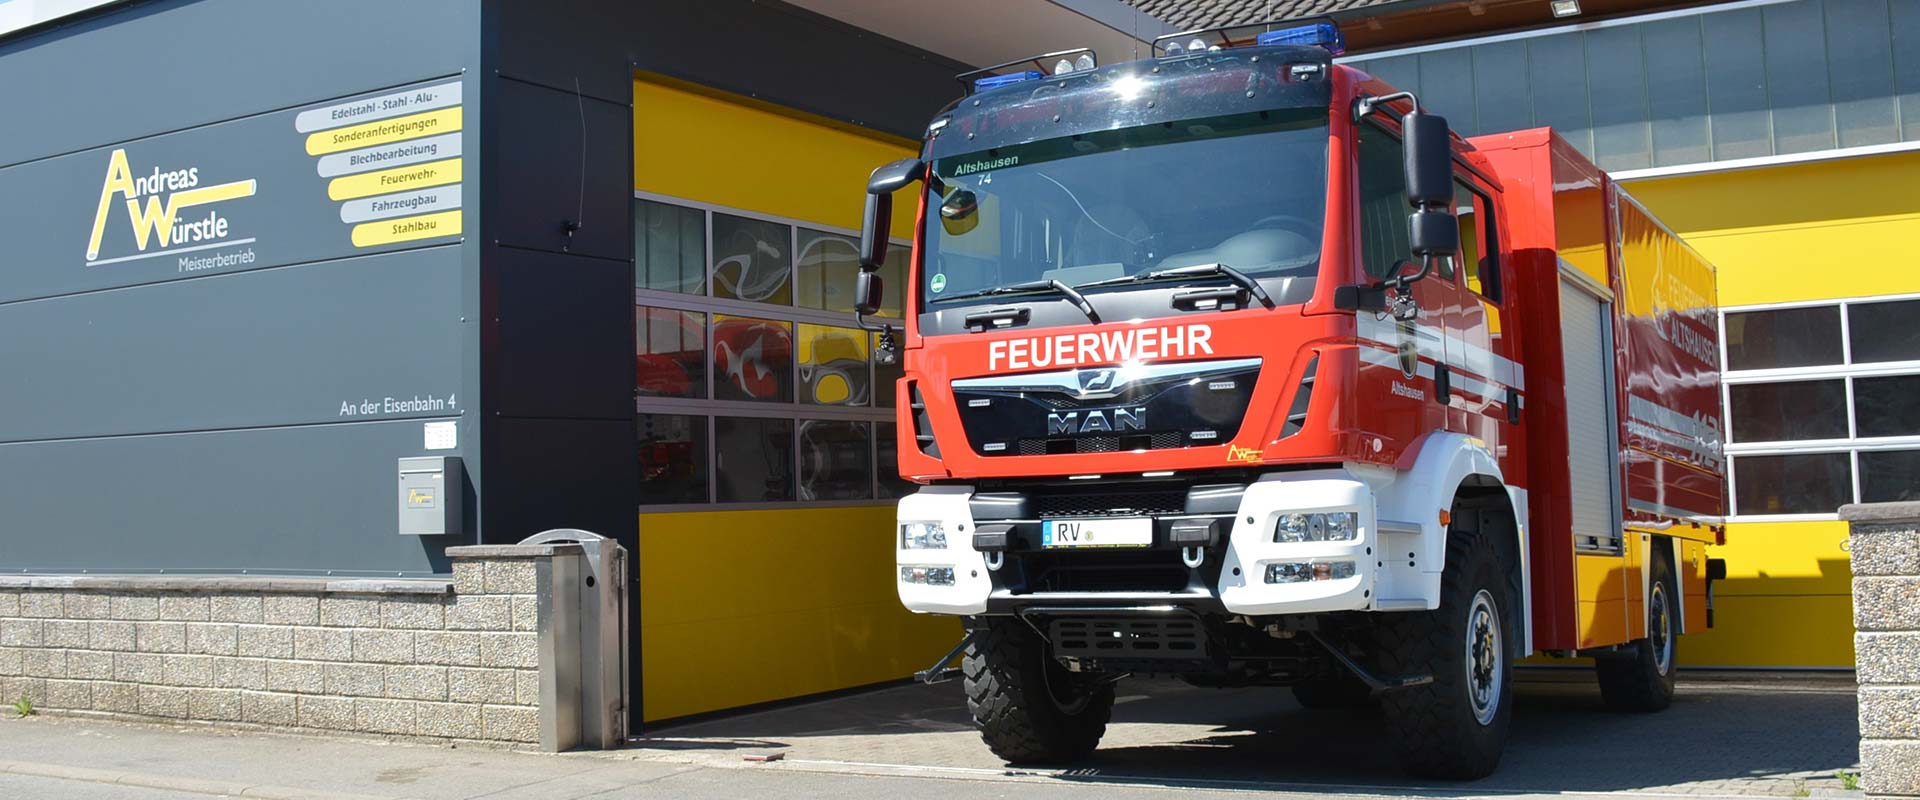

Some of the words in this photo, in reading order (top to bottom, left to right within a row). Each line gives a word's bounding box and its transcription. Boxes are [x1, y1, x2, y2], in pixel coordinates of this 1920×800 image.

[332, 103, 376, 120] Edelstahl
[383, 96, 408, 110] Stahl
[415, 92, 433, 104] Alu
[333, 118, 438, 144] Sonderanfertigungen
[350, 143, 438, 166] Blechbearbeitung
[954, 155, 1019, 176] Altshausen
[380, 169, 437, 186] Feuerwehr-
[978, 173, 992, 186] 74
[86, 148, 199, 261] Andreas
[371, 195, 437, 213] Fahrzeugbau
[392, 220, 437, 235] Stahlbau
[178, 248, 256, 273] Meisterbetrieb
[988, 324, 1214, 371] FEUERWEHR
[1391, 379, 1425, 401] Altshausen
[339, 401, 357, 416] An
[360, 399, 381, 415] der
[384, 395, 443, 413] Eisenbahn
[447, 393, 456, 409] 4
[1048, 407, 1147, 436] MAN
[1058, 523, 1080, 542] RV
